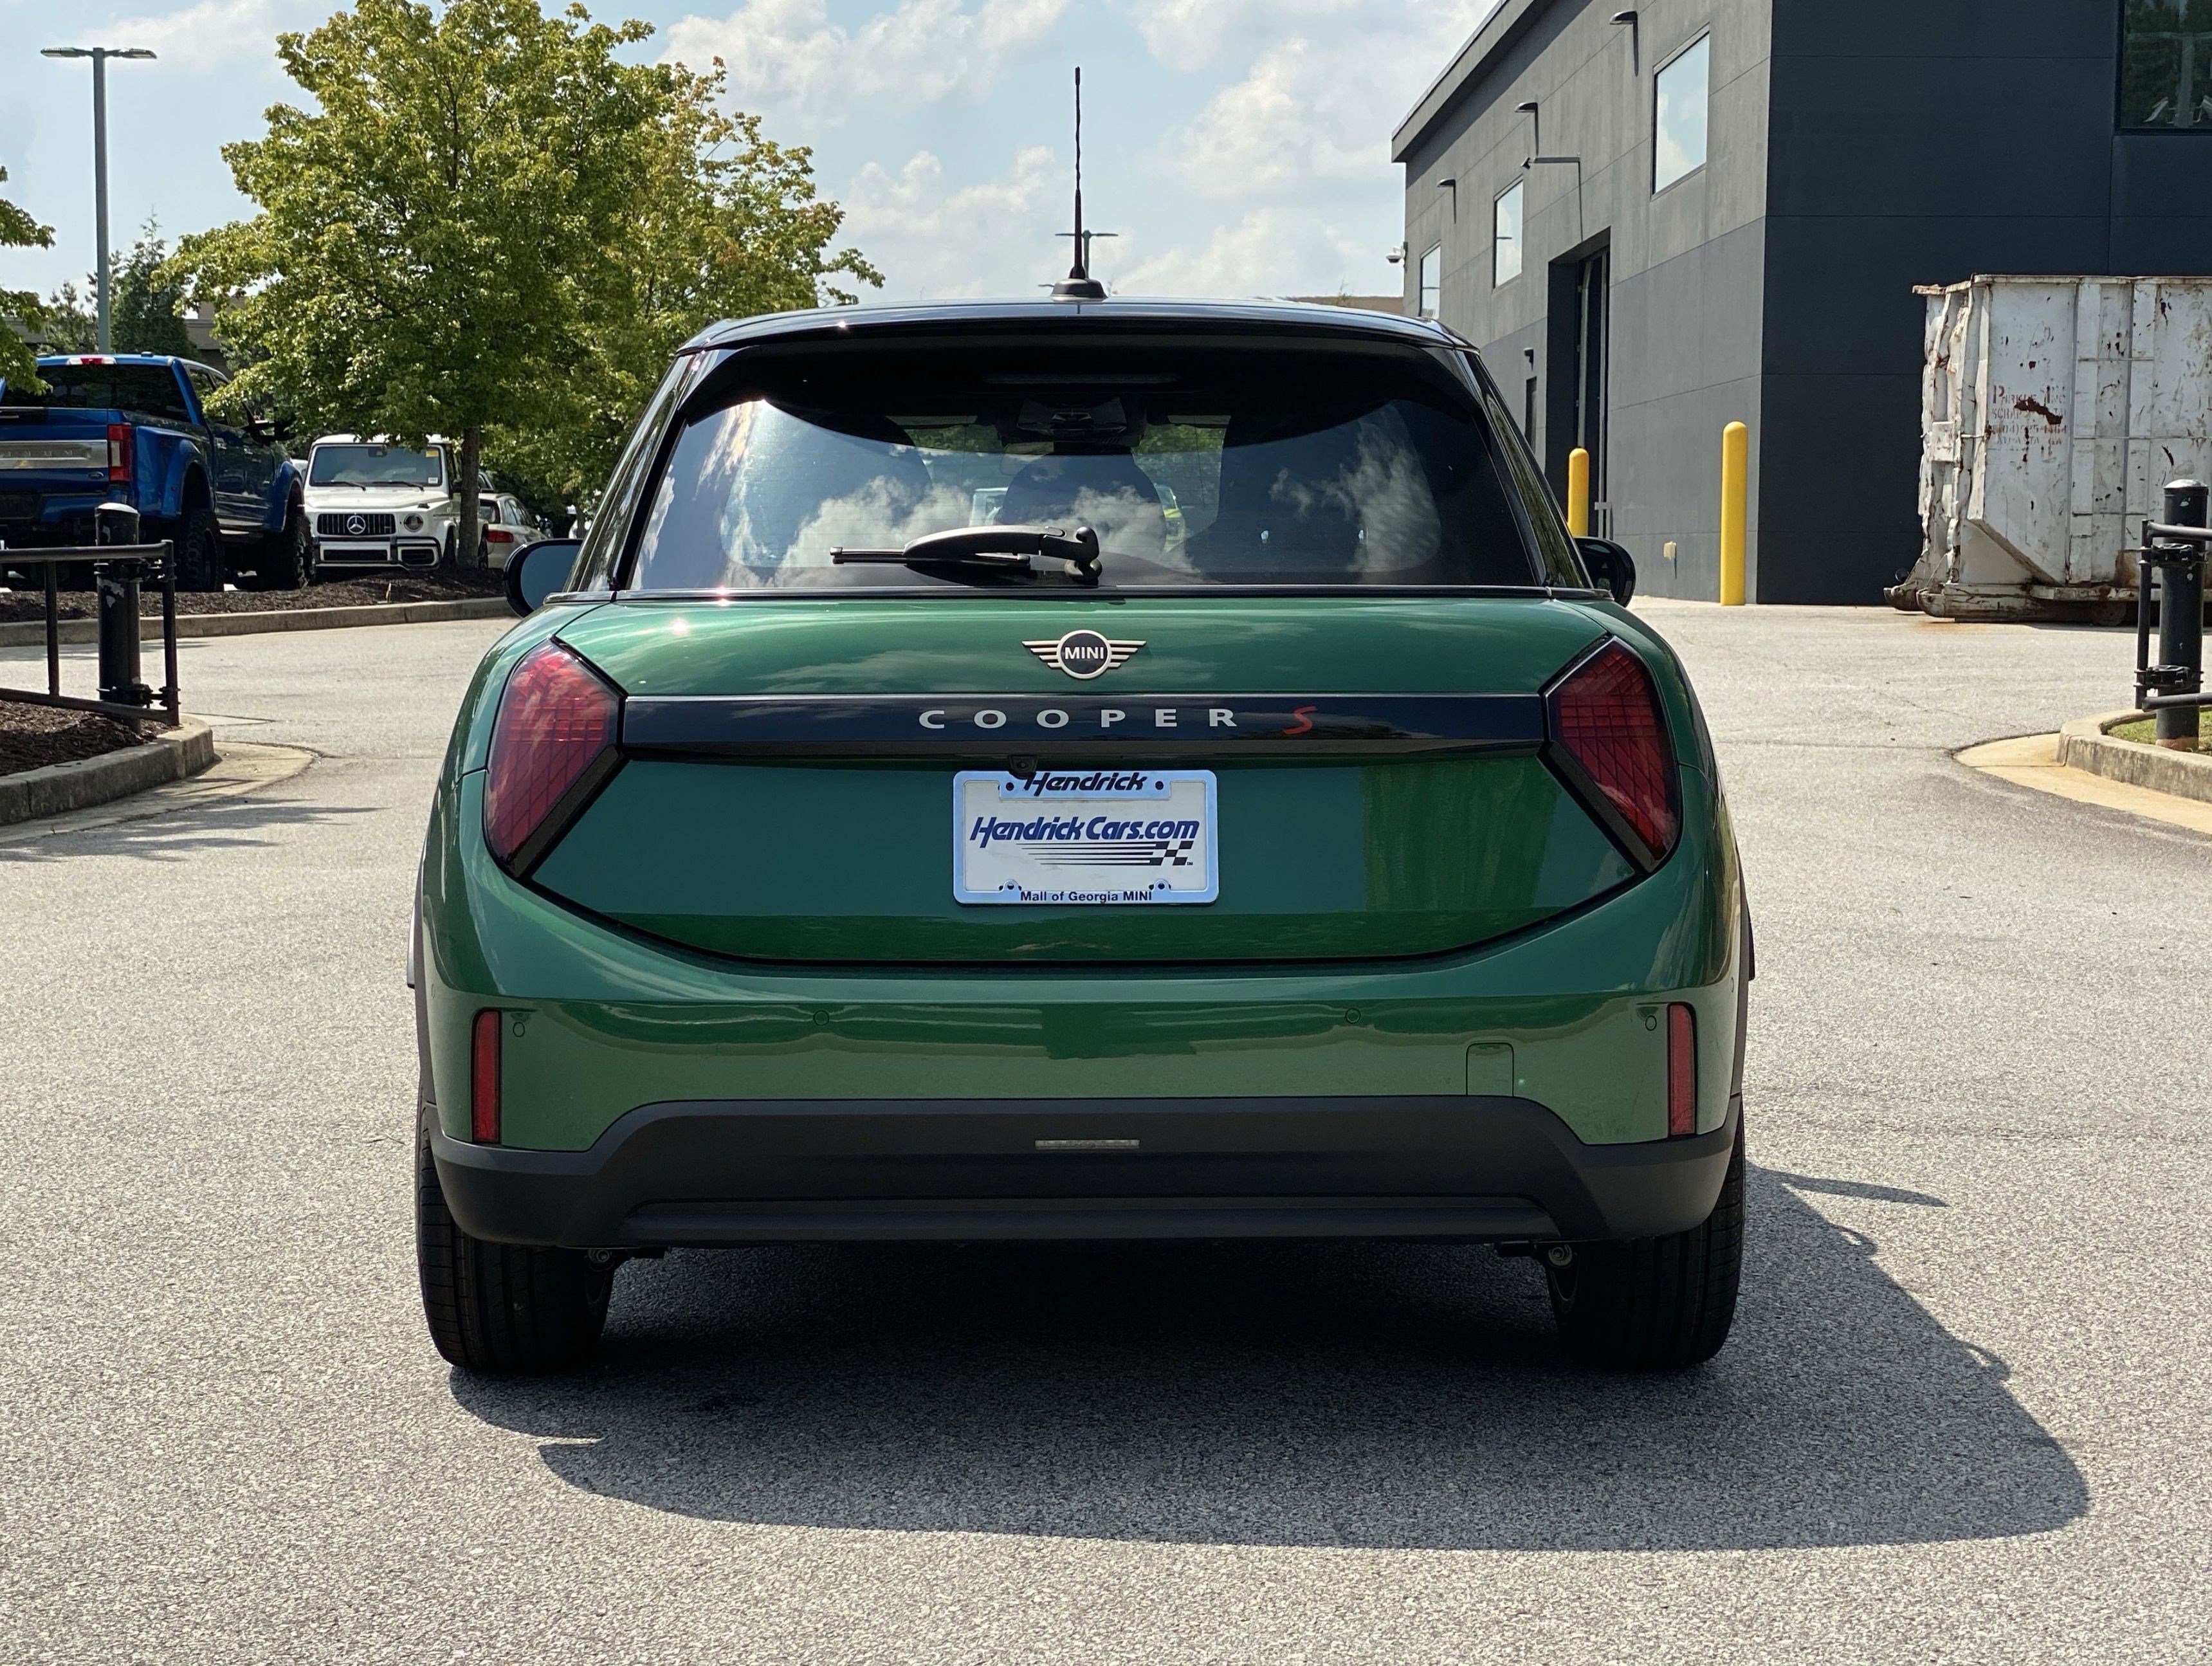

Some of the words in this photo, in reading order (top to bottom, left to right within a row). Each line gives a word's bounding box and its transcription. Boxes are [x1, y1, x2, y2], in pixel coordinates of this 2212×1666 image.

[1064, 646, 1105, 661] MINI
[919, 709, 1238, 729] COOPER
[1283, 706, 1317, 734] S
[1023, 772, 1147, 796] Hendrick
[1020, 891, 1047, 901] Mall
[1052, 891, 1065, 901] of
[1068, 891, 1119, 904] Georgia
[1123, 891, 1152, 901] MINI
